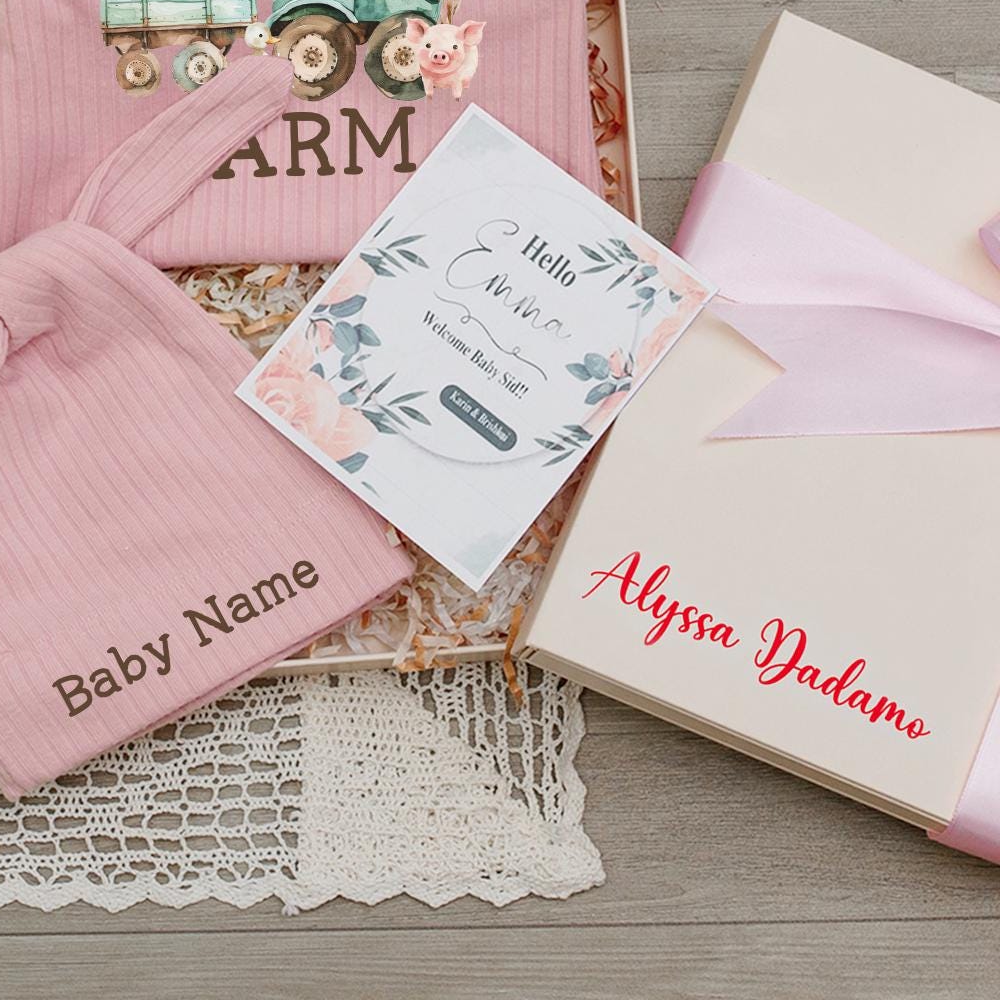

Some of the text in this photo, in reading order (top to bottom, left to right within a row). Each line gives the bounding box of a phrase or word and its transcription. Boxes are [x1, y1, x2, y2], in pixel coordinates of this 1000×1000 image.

[211, 106, 417, 180] ARM
[446, 219, 572, 339] Emma
[520, 234, 577, 288] Hello
[422, 310, 472, 356] Welcome
[470, 349, 500, 380] Baby
[470, 408, 481, 420] &
[51, 560, 320, 717] Baby Name
[582, 550, 931, 739] Alyssa Dadamo
